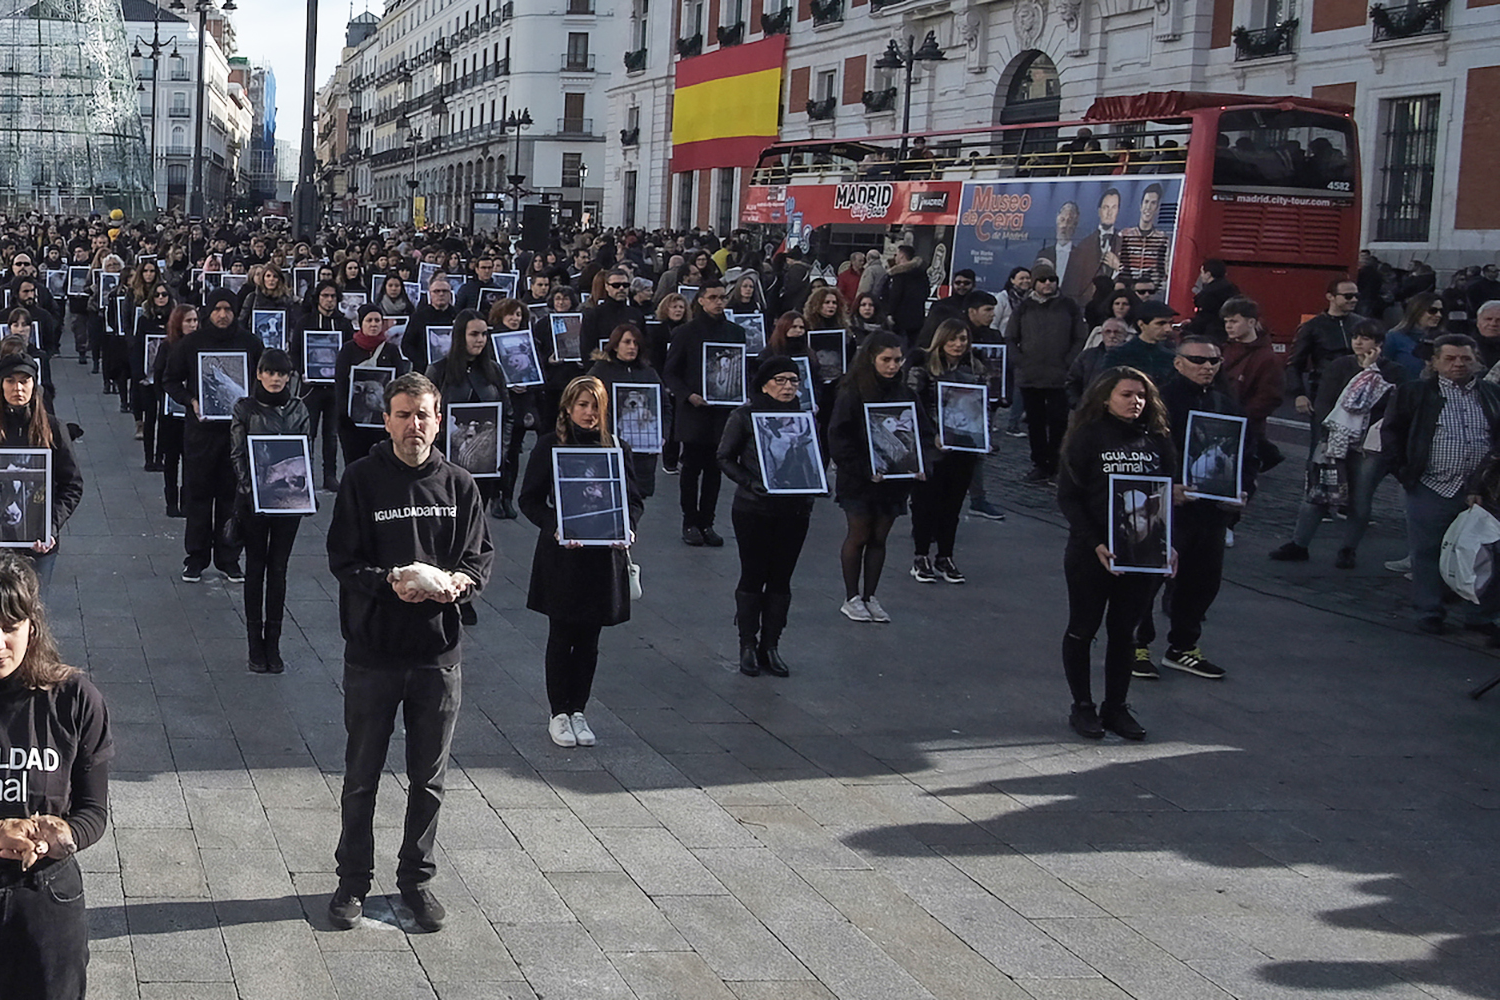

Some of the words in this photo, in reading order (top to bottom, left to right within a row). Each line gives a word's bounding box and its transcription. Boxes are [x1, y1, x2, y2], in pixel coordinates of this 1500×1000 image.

[1327, 181, 1350, 191] 4582
[834, 183, 893, 209] MADRID
[971, 185, 1032, 213] Museo
[1236, 195, 1330, 207] madrid.city-tour.com
[961, 209, 978, 226] de
[975, 212, 1025, 242] Cera
[1102, 460, 1143, 473] animal
